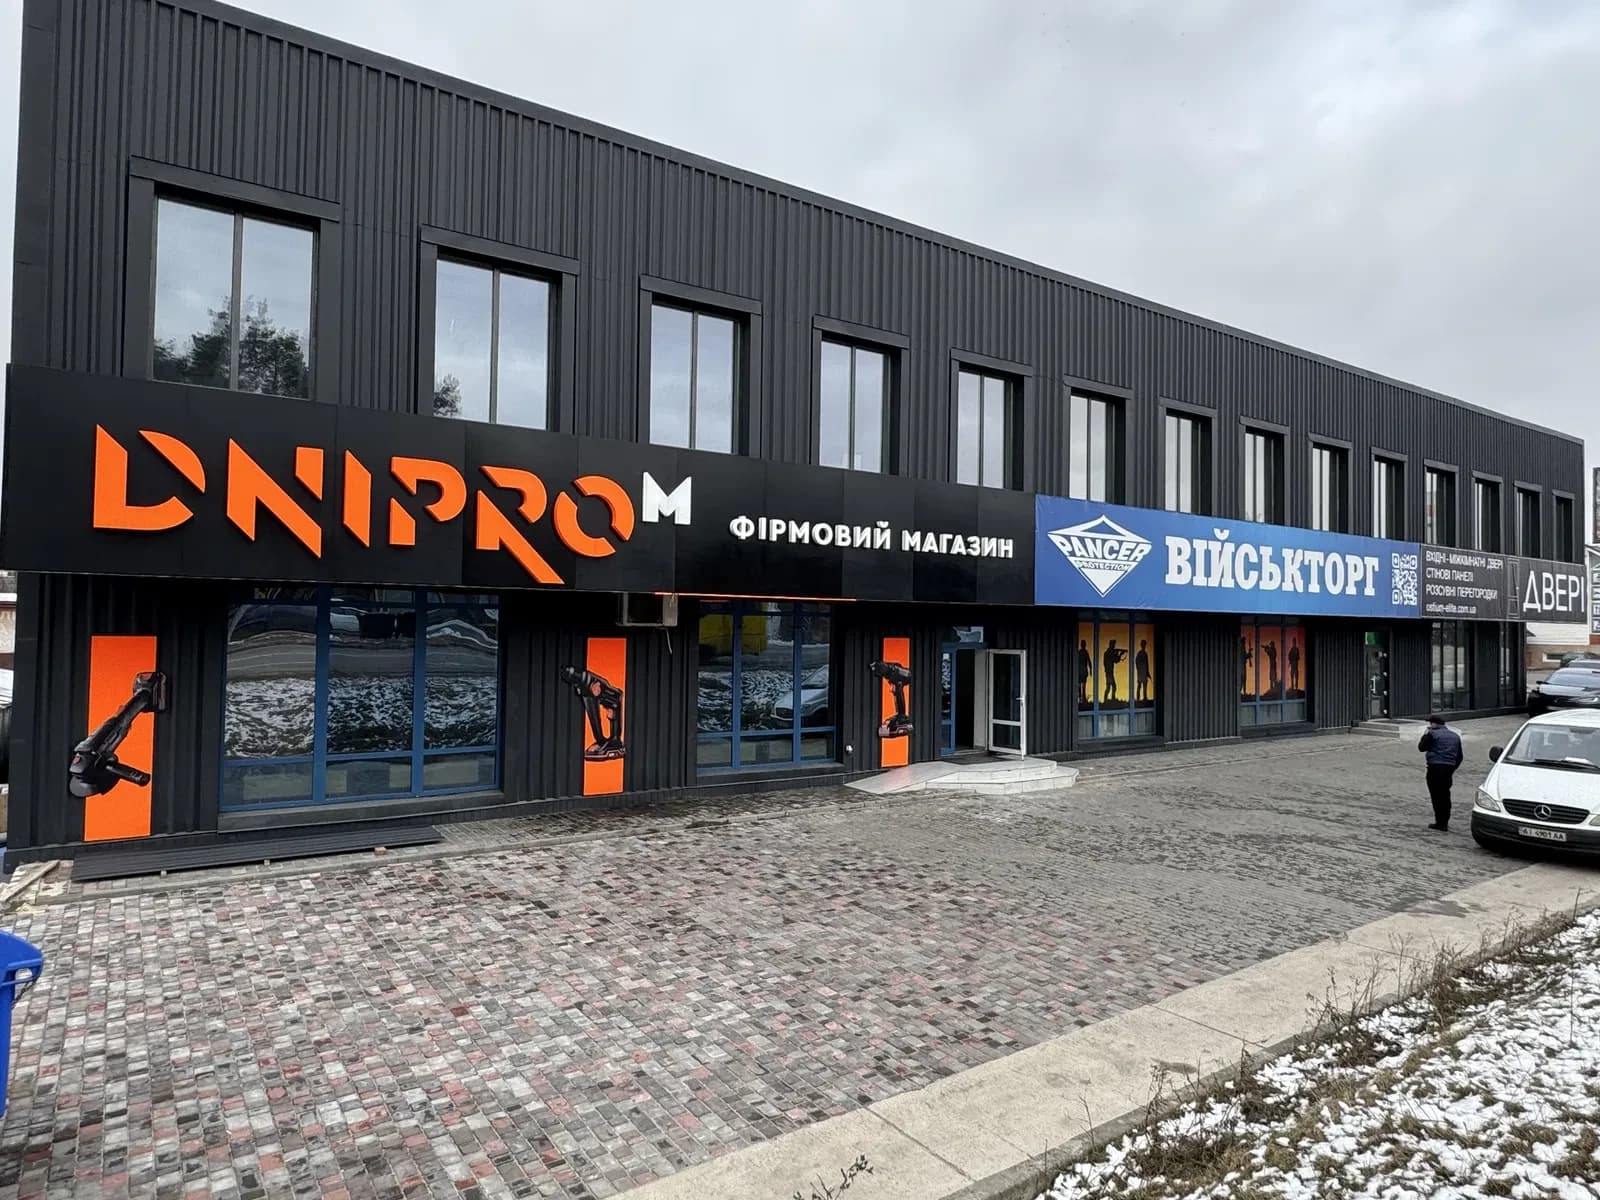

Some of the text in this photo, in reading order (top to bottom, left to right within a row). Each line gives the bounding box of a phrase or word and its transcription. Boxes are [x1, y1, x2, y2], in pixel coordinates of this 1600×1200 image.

[93, 427, 691, 584] DNIPRO M
[730, 516, 1013, 558] ФІРМОВИЙ МАГАЗИН
[1047, 533, 1152, 562] PANCER
[1074, 560, 1132, 572] PROTECTION
[1165, 528, 1379, 596] ВІЙСЬКТОРГ
[1426, 567, 1474, 582] СТІНОВІ ПАНЕЛІ
[1426, 584, 1456, 597] РОЗСУВНІ
[1522, 570, 1585, 613] ДВЕРІ
